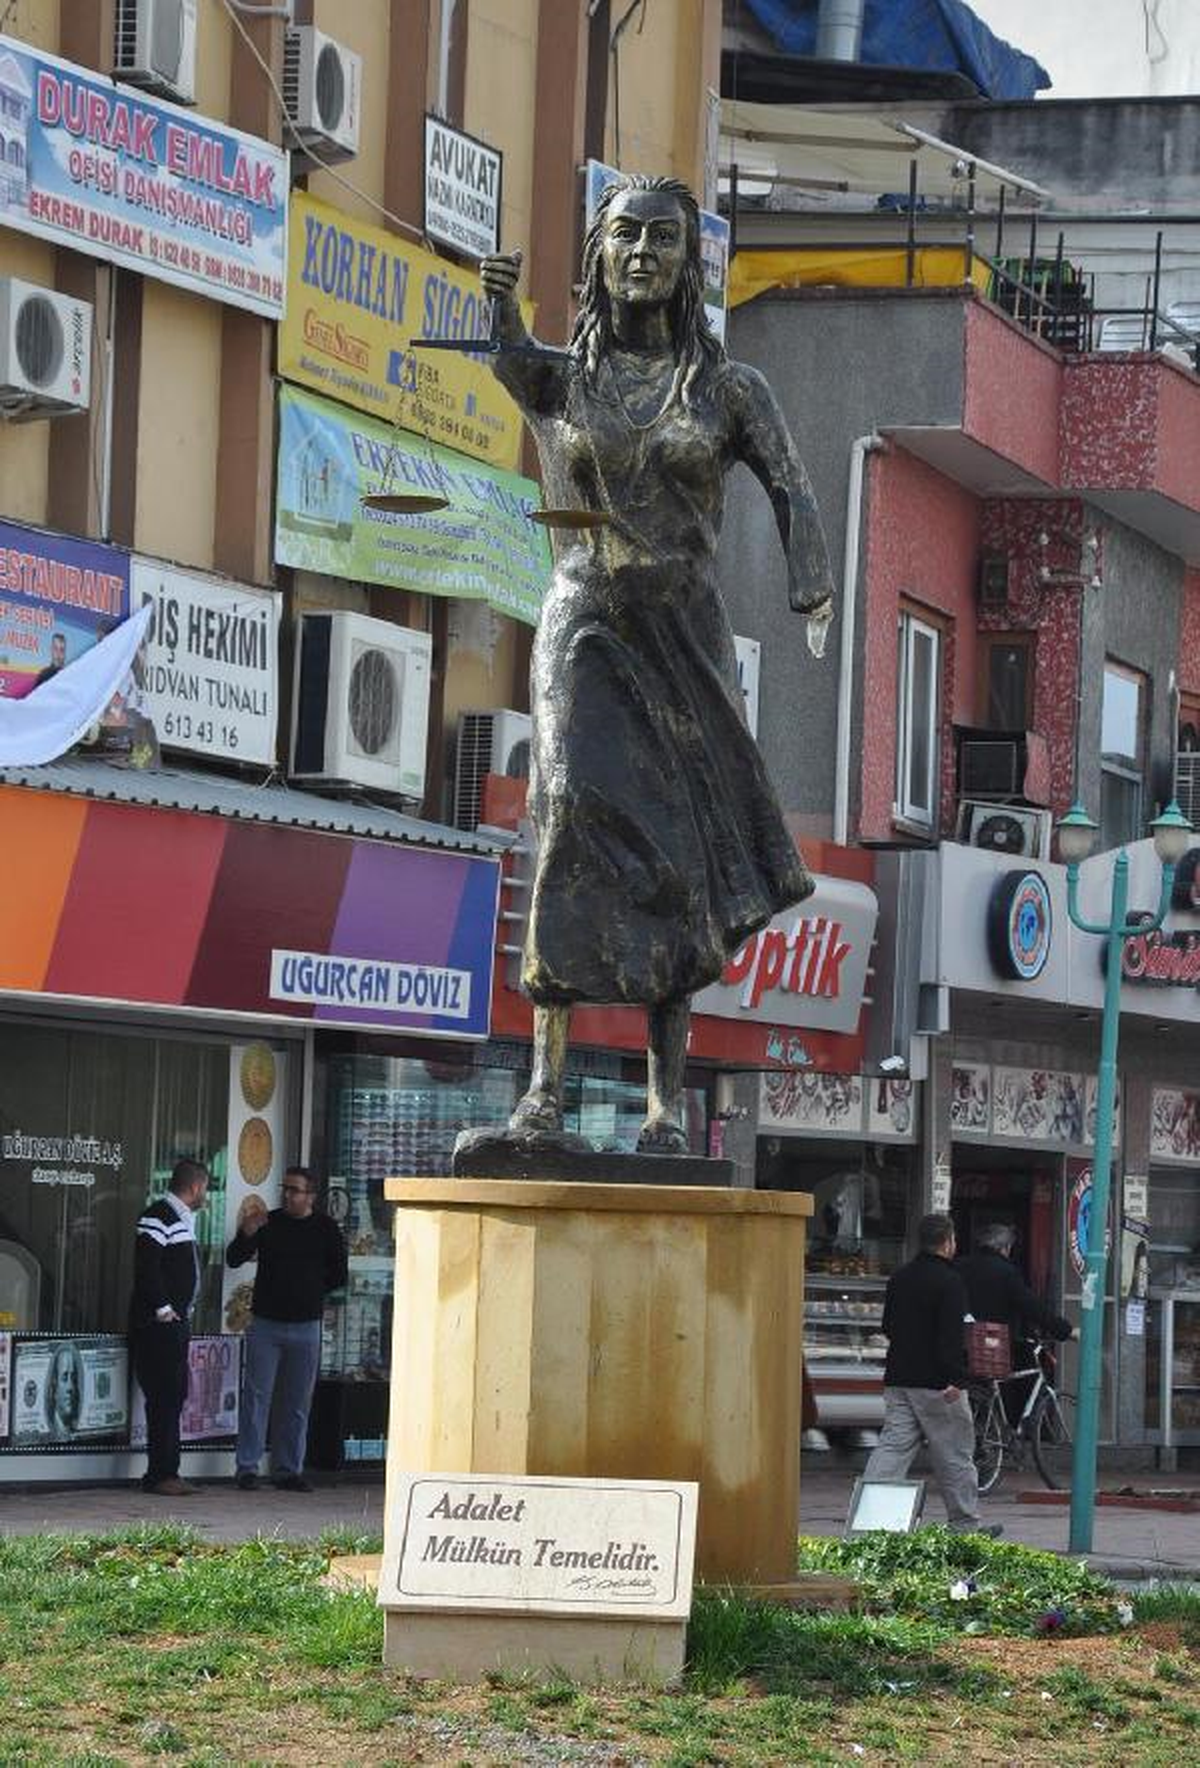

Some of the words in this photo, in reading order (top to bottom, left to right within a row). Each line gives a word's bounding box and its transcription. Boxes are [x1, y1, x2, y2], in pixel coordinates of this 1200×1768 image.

[38, 70, 158, 166] DURAK
[167, 124, 276, 212] EMLAK
[430, 129, 497, 198] AVUKAT
[30, 191, 84, 232] EKREM
[89, 208, 143, 255] DURAK
[301, 214, 409, 326] KORHAN
[142, 585, 179, 663] DİŞ
[188, 604, 267, 671] HEKİMİ
[205, 678, 268, 716] TUNALI
[164, 712, 191, 739] 613
[197, 721, 213, 743] 43
[222, 726, 238, 748] 16
[281, 956, 390, 1003] UĞURCAN
[397, 968, 462, 1009] DÖVİZ
[427, 1492, 526, 1522] Adalet
[422, 1535, 522, 1567] Mülkün
[532, 1538, 660, 1572] Temelidir.
